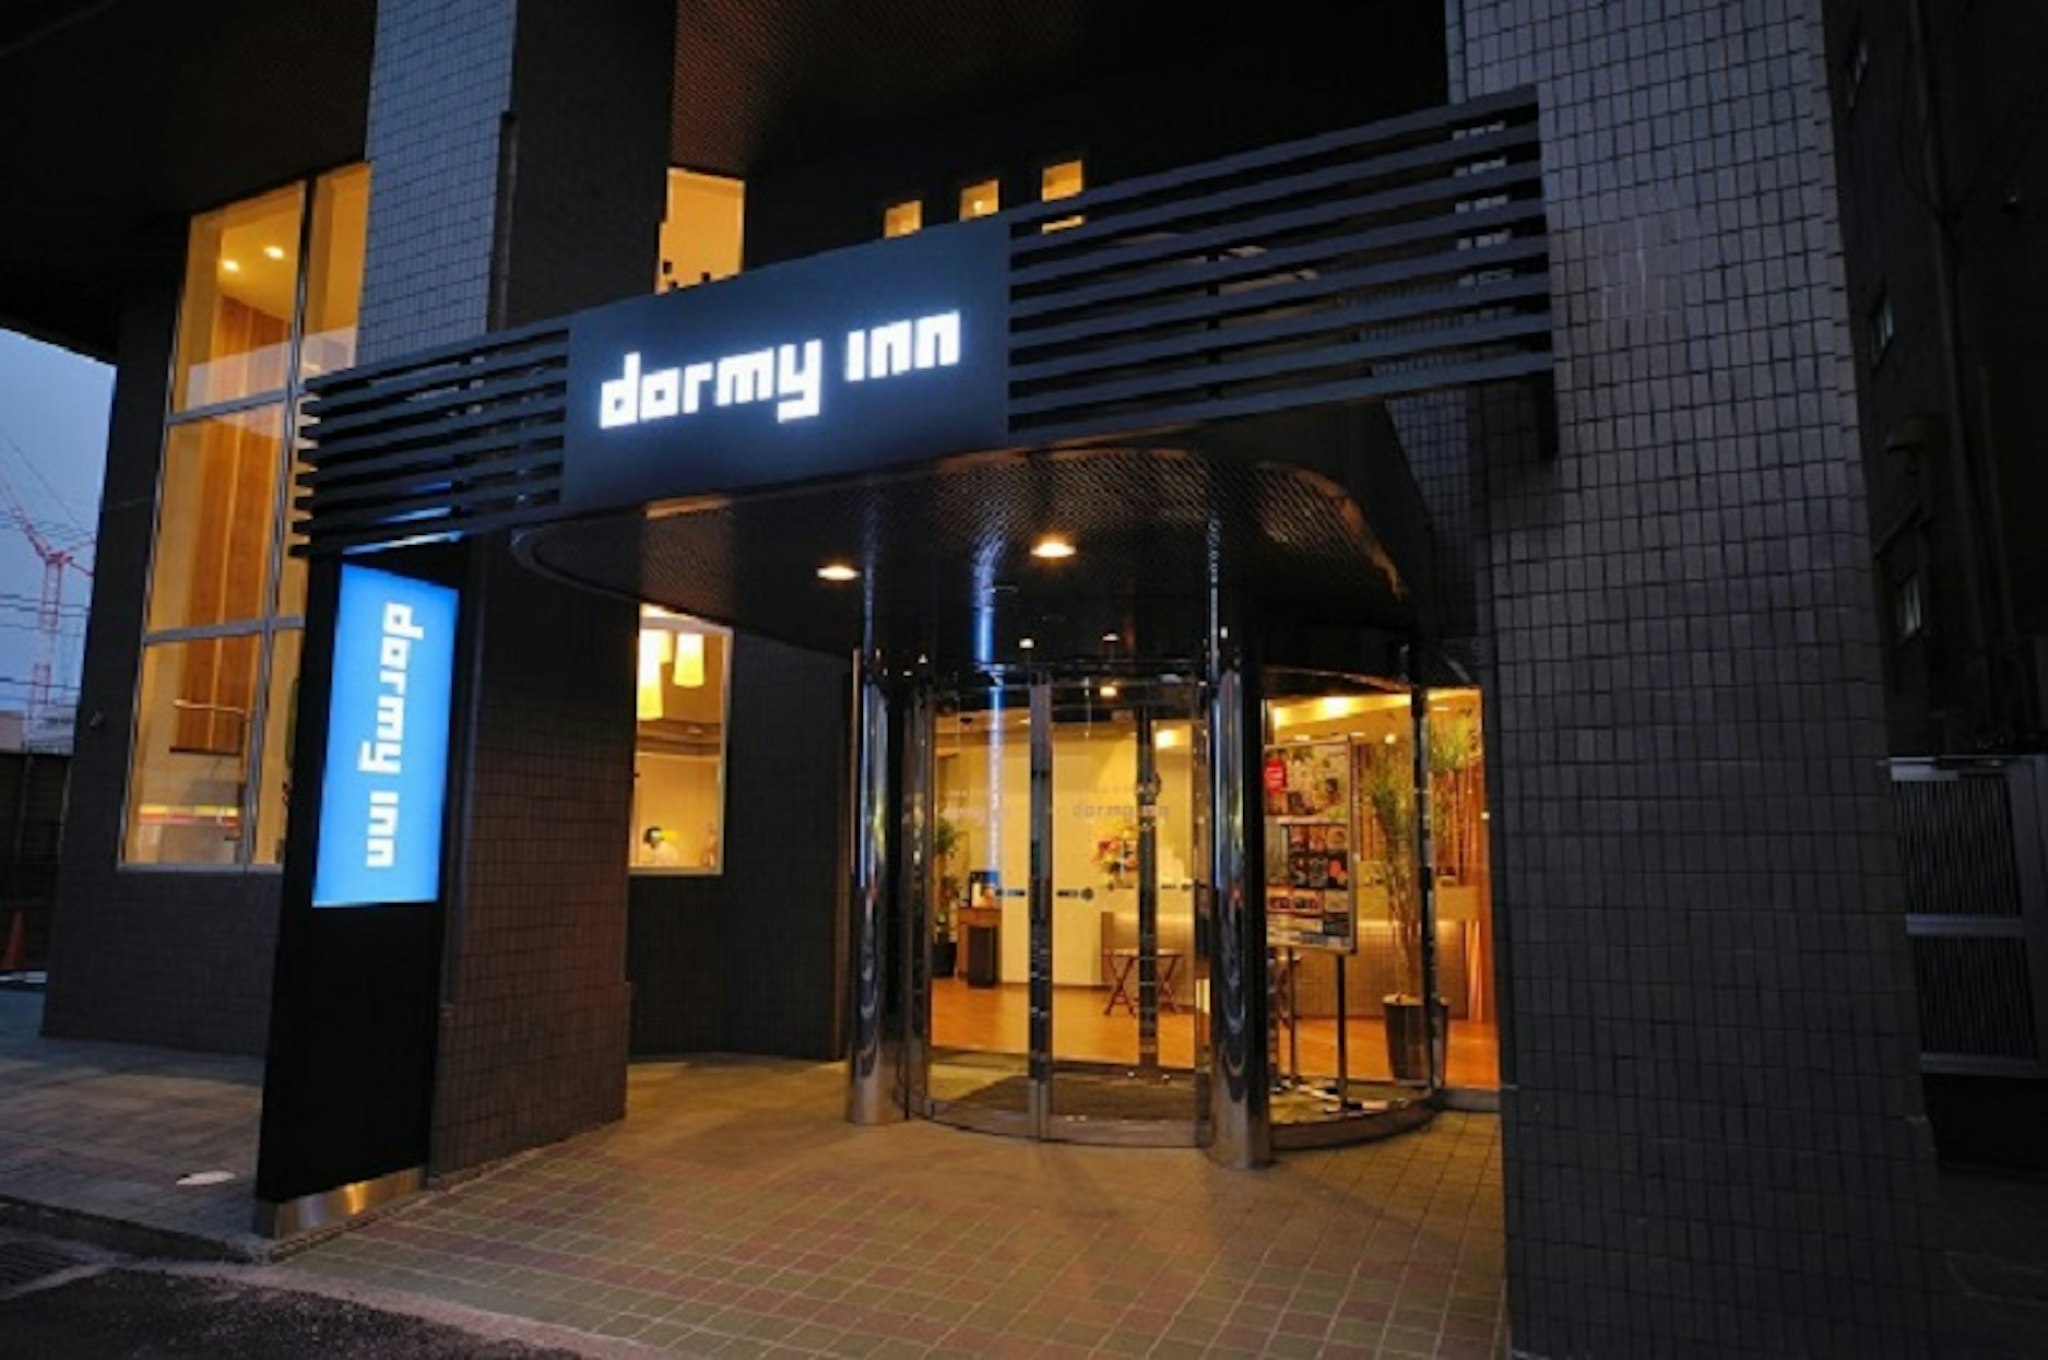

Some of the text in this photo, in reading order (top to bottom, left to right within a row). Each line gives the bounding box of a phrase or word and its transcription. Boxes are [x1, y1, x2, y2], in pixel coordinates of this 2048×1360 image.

[600, 311, 960, 429] dormy inn
[358, 602, 424, 868] dormy inn
